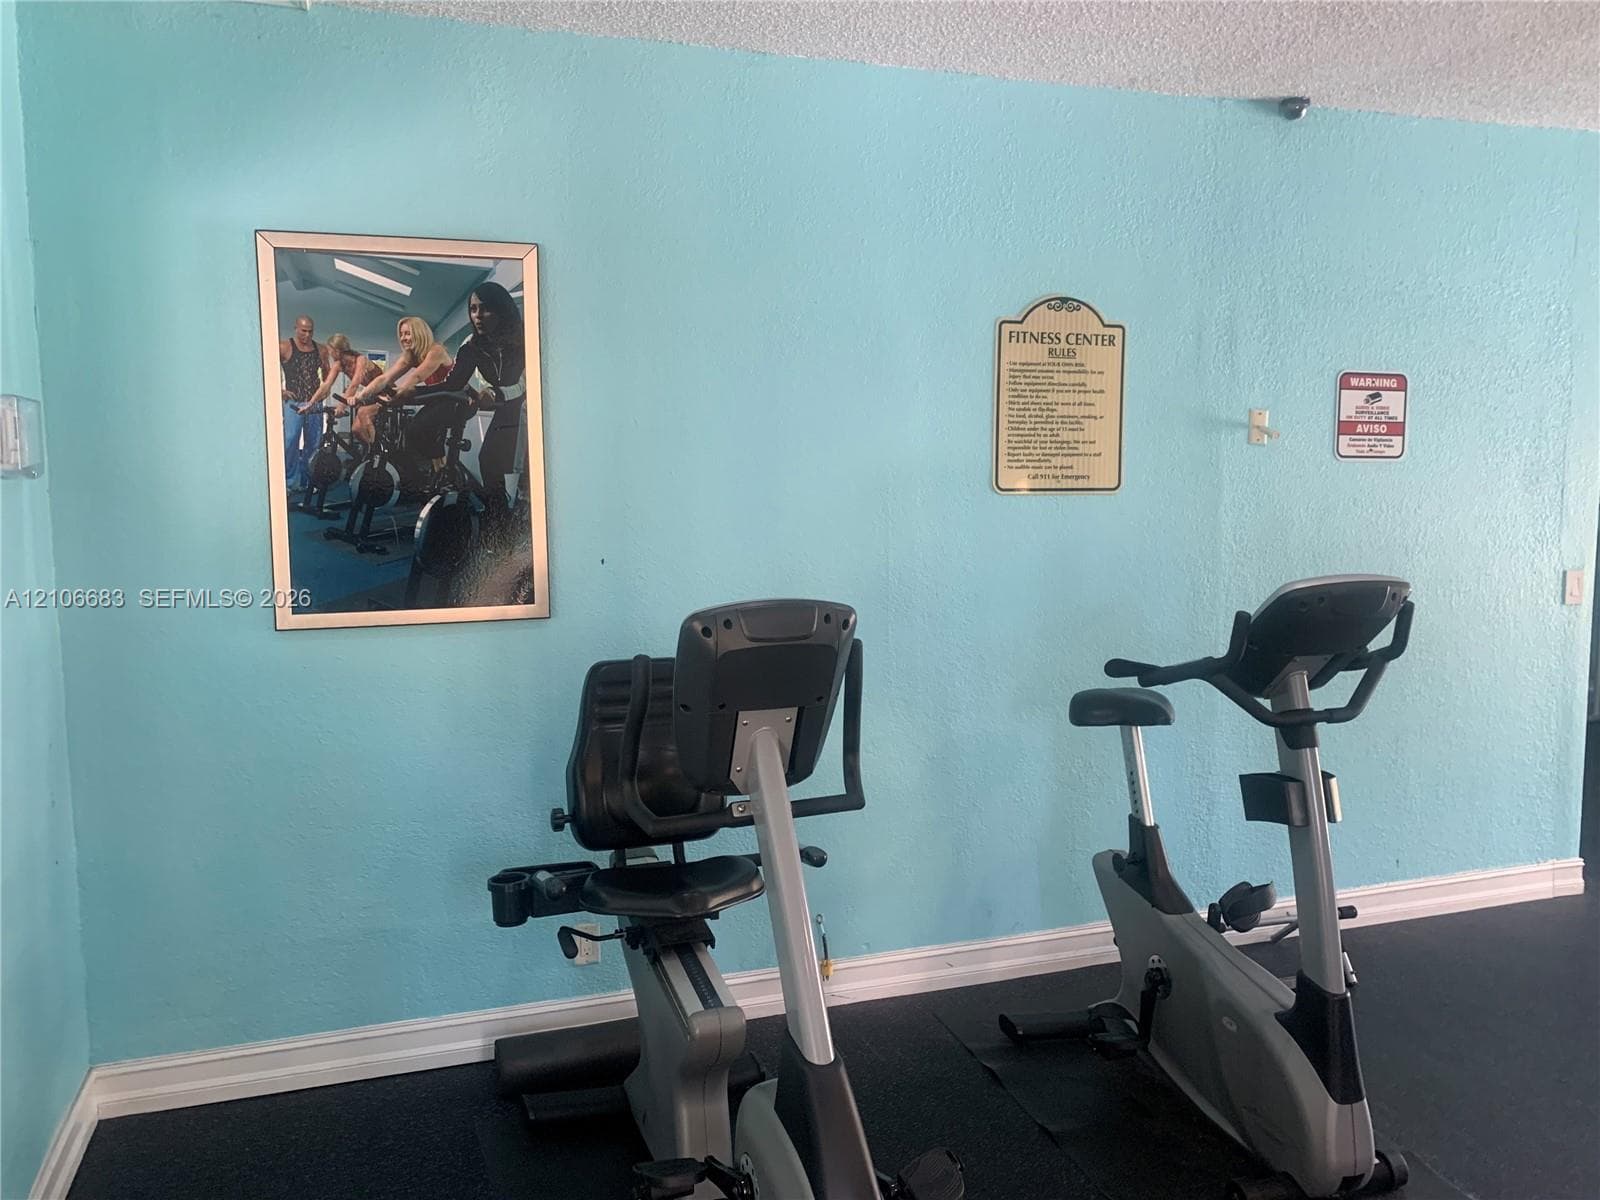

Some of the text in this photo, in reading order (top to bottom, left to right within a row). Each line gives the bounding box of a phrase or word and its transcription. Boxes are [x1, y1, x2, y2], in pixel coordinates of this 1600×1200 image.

[1008, 330, 1116, 346] FITNESS CENTER
[1048, 347, 1077, 358] RULES
[1350, 376, 1398, 388] WARNING
[1356, 424, 1388, 433] AVISO
[1061, 474, 1090, 482] Emergency
